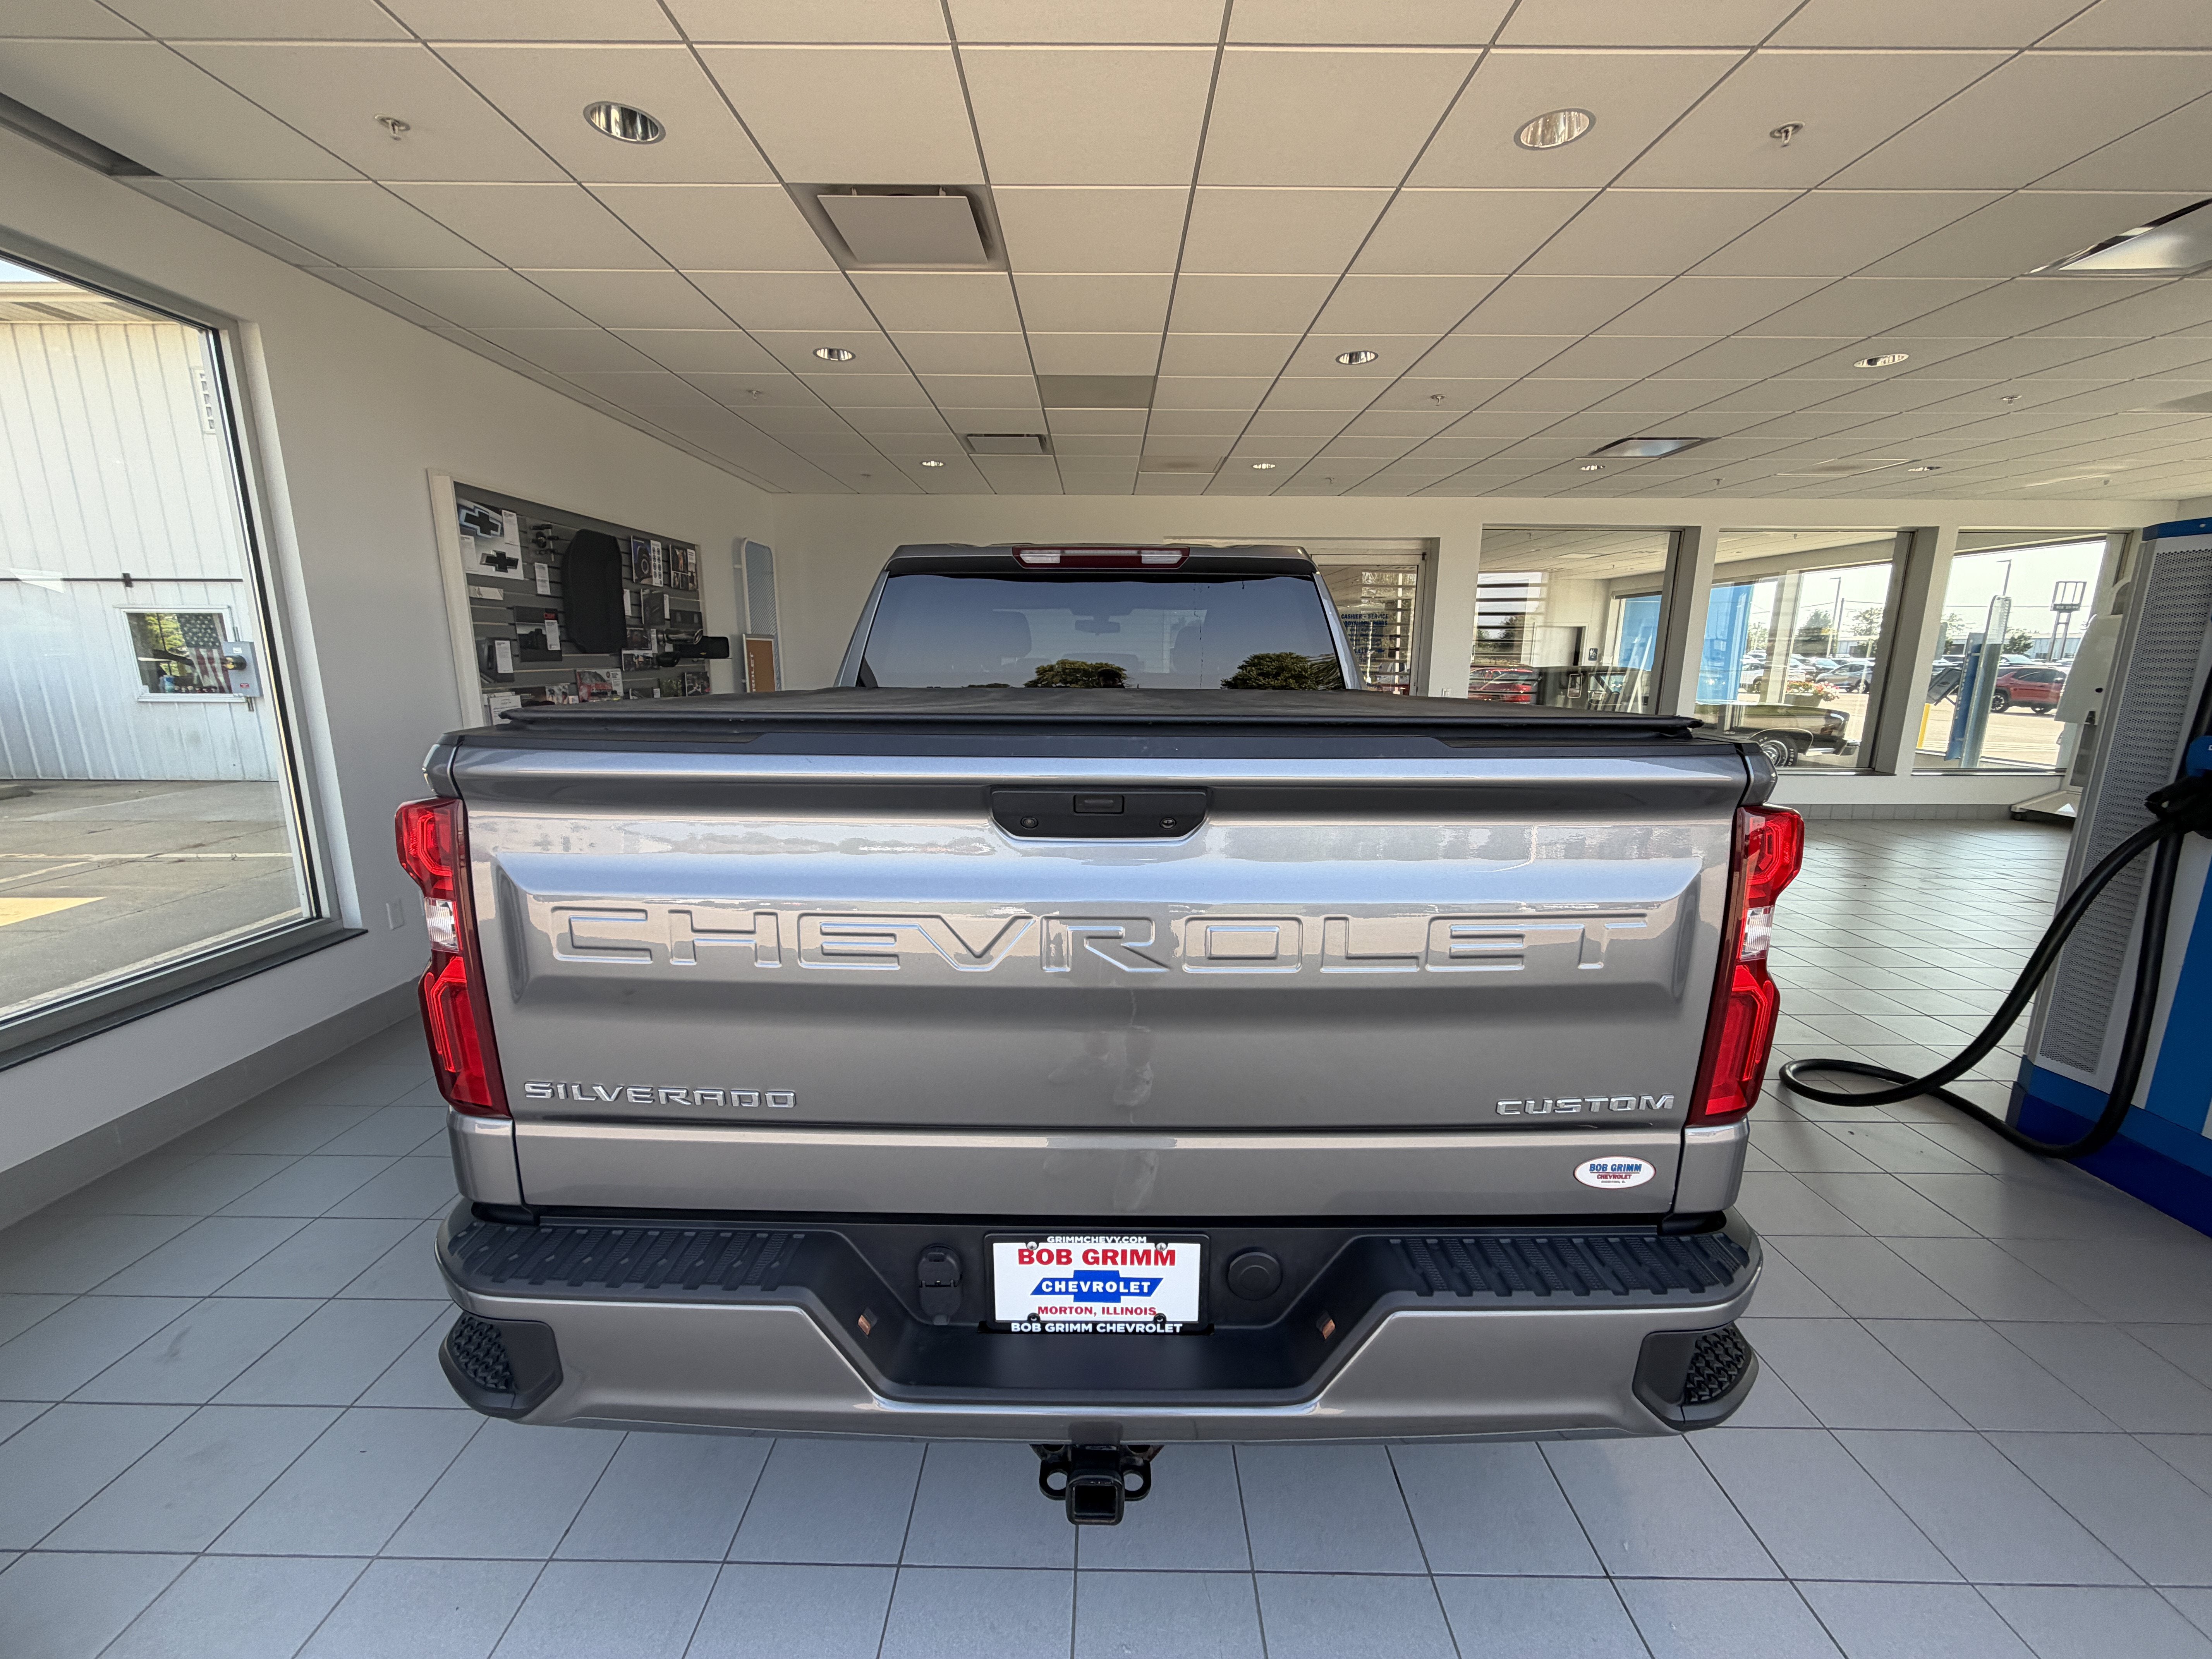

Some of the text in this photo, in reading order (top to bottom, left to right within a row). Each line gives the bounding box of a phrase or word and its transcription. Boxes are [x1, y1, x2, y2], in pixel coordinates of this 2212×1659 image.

[551, 906, 1647, 973] CHEVROLET
[524, 1081, 797, 1108] SILVERADO
[1496, 1094, 1675, 1115] CUSTOM
[1589, 1163, 1642, 1172] BOB GRIMM
[1047, 1236, 1147, 1244] GRIMMCHEVY.COM
[1018, 1249, 1176, 1266] BOB GRIMM
[1042, 1280, 1151, 1293] CHEVROLET
[1037, 1306, 1157, 1317] MORTON, ILLINOIS
[1011, 1322, 1183, 1333] BOB GRIMM CHEVROLET
